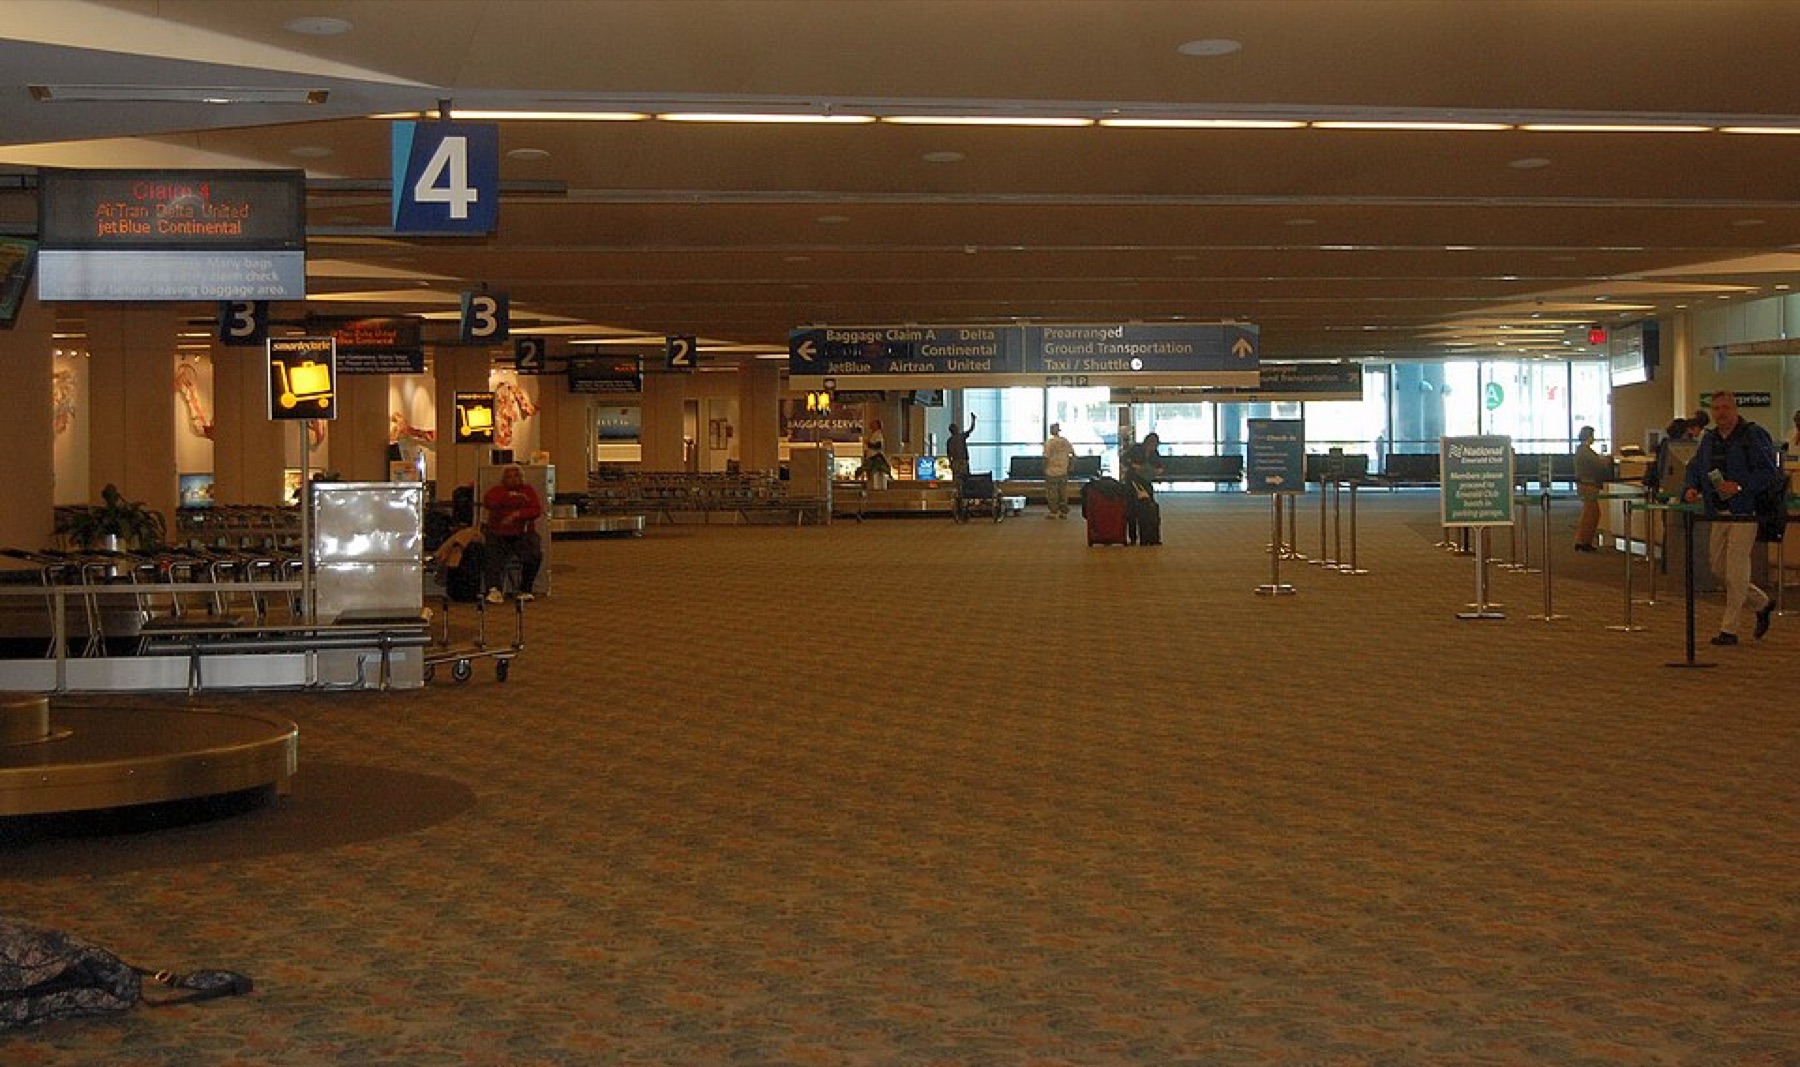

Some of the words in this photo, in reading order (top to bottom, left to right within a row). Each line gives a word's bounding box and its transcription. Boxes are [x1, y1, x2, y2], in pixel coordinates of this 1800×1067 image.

[414, 136, 478, 219] 4
[157, 204, 194, 219] Delta
[201, 204, 249, 218] United
[97, 220, 151, 237] jetBlue
[157, 219, 241, 235] Continental
[243, 257, 273, 272] bags
[245, 270, 279, 283] check
[200, 283, 254, 299] baggage
[230, 300, 257, 337] 3
[471, 296, 498, 338] 3
[826, 329, 882, 344] Baggage
[886, 329, 922, 341] Claim
[925, 330, 937, 341] A
[959, 329, 995, 341] Delta
[1043, 326, 1123, 341] Prearranged
[520, 342, 537, 367] 2
[671, 339, 689, 365] 2
[921, 344, 997, 356] Continental
[1045, 341, 1094, 354] Ground
[1097, 341, 1193, 357] Transportation
[827, 361, 871, 373] JetBlue
[888, 360, 935, 372] Airtran
[947, 359, 991, 371] United
[1044, 359, 1071, 371] Taxi
[1084, 358, 1130, 371] Shuttle
[832, 419, 864, 429] SERVIC
[1462, 445, 1504, 457] National
